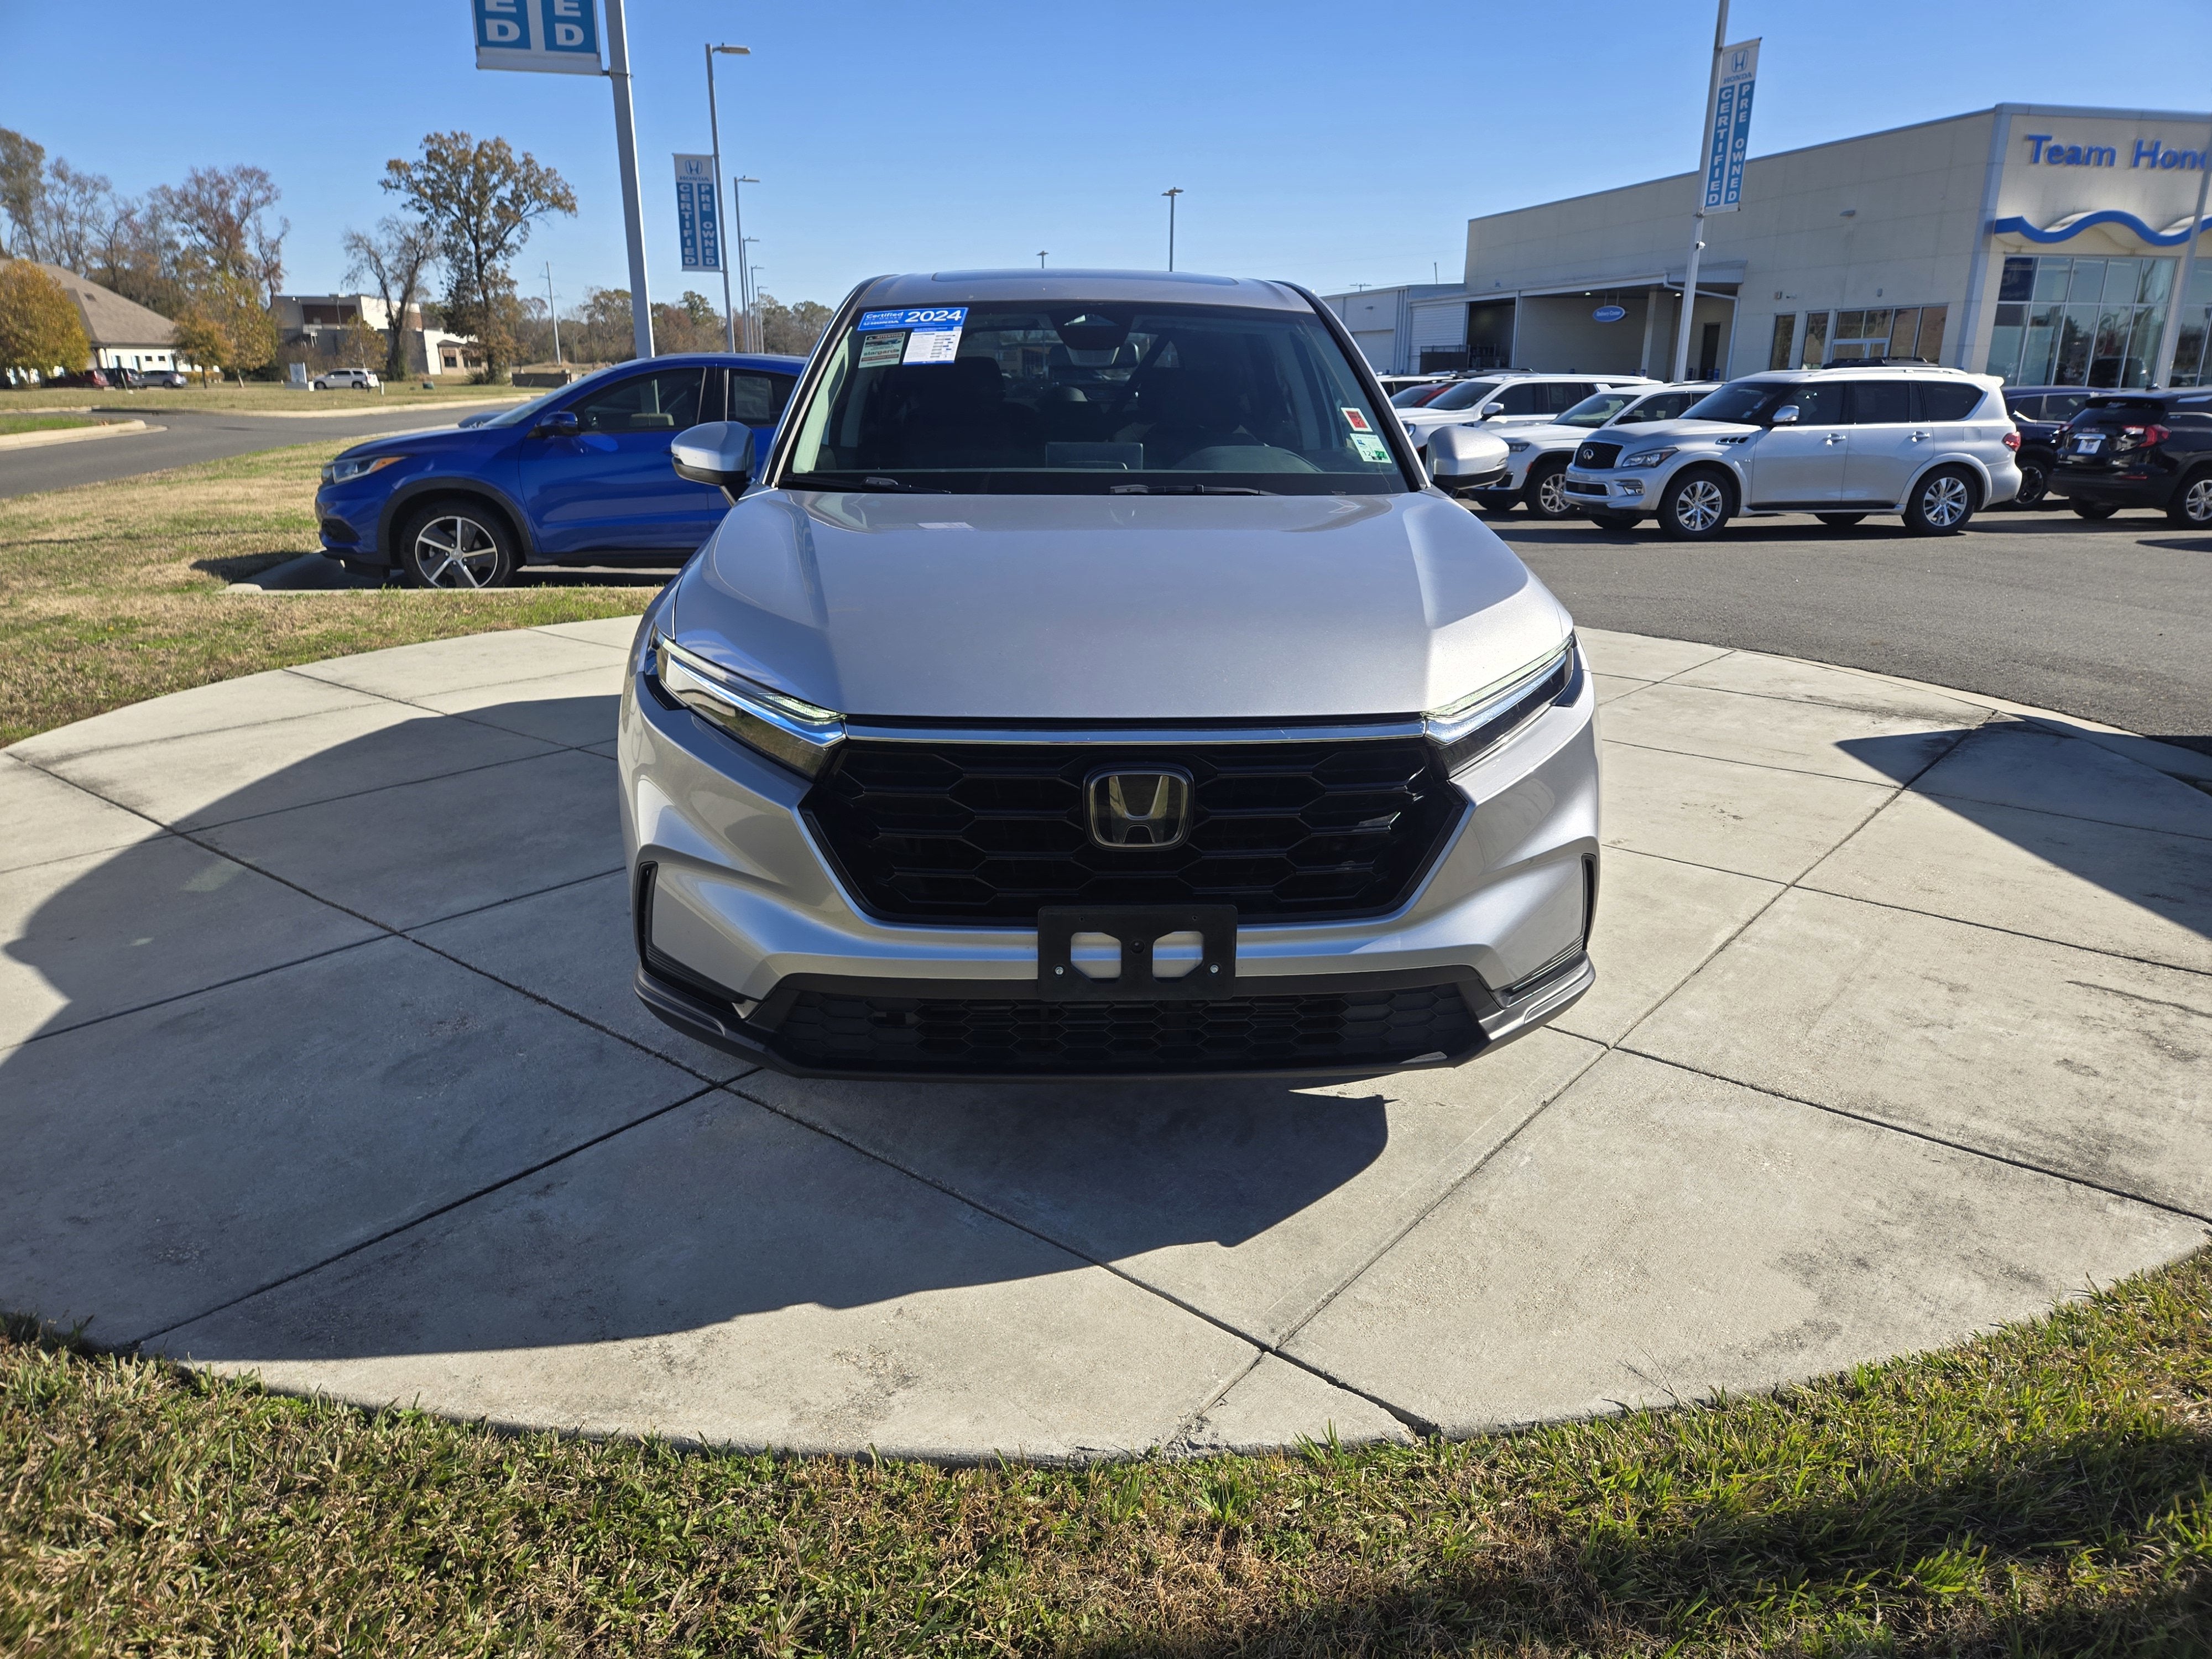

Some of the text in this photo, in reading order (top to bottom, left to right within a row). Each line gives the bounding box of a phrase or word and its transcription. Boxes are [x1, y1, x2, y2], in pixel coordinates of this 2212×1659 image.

[1723, 72, 1752, 84] HONDA
[1708, 88, 1732, 204] CERTIFIED
[1728, 84, 1750, 201] PRE OWNED
[2028, 134, 2116, 167] Team
[679, 184, 696, 264] CERTIFIED
[701, 185, 715, 265] PRE OWNED
[905, 310, 962, 322] 2024
